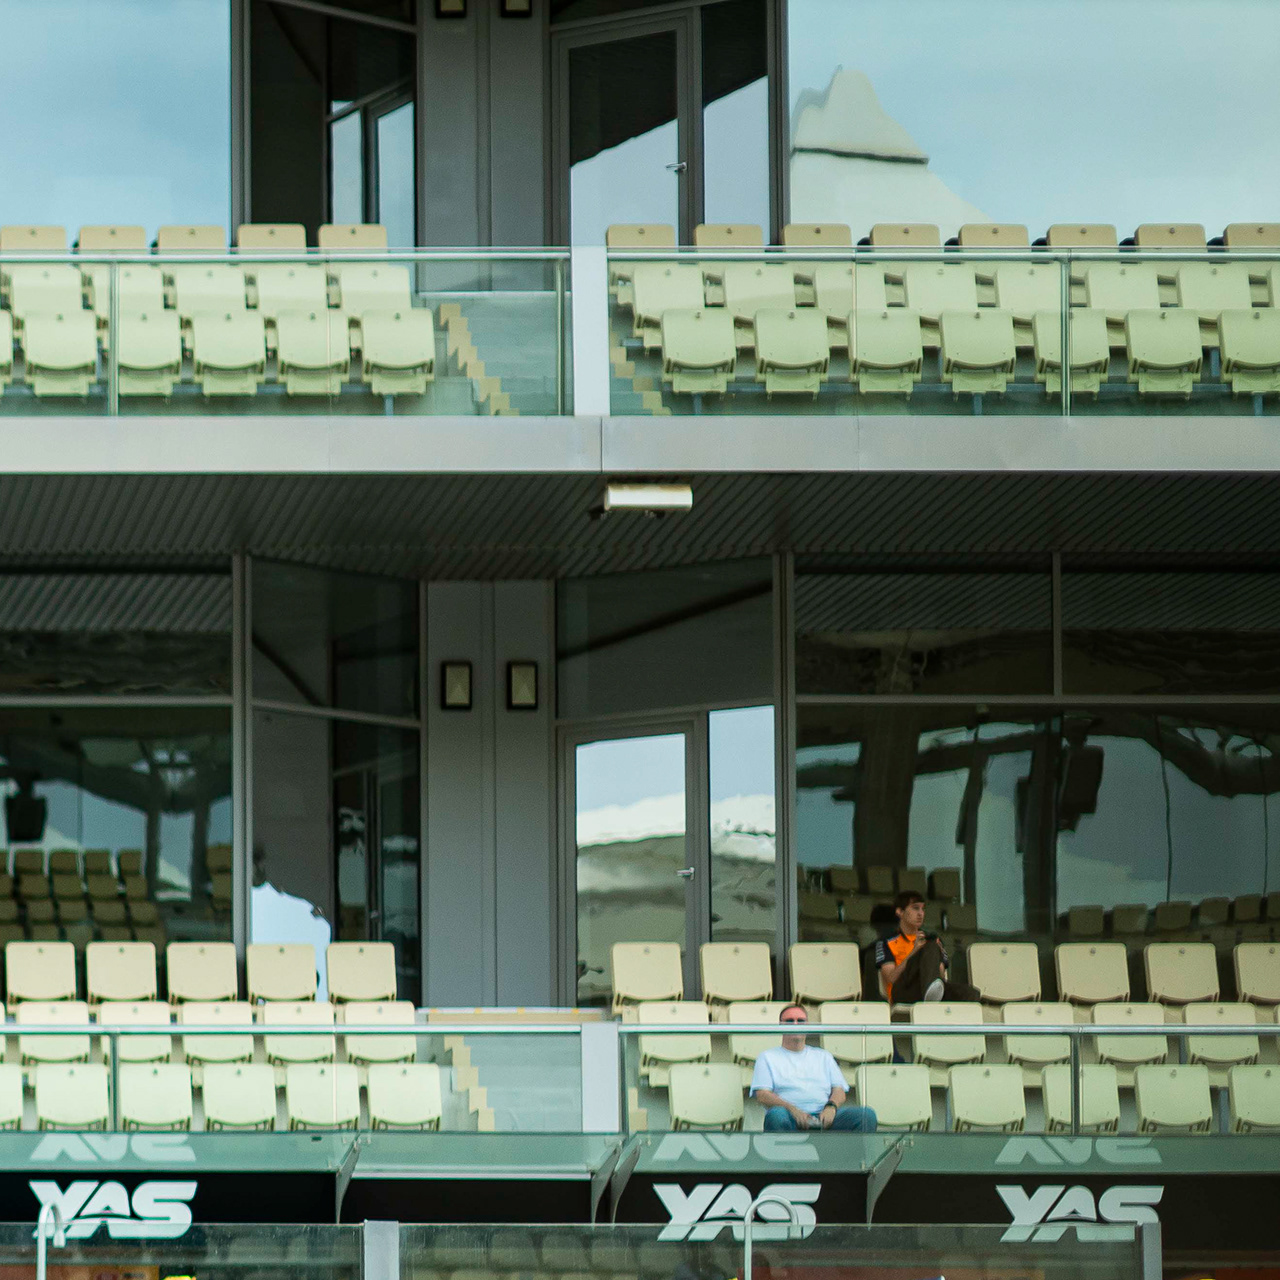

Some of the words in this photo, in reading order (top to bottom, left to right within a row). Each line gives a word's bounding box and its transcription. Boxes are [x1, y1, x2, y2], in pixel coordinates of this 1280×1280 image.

[29, 1181, 198, 1239] YAS
[652, 1183, 822, 1242] YAS
[996, 1186, 1165, 1243] YAS
